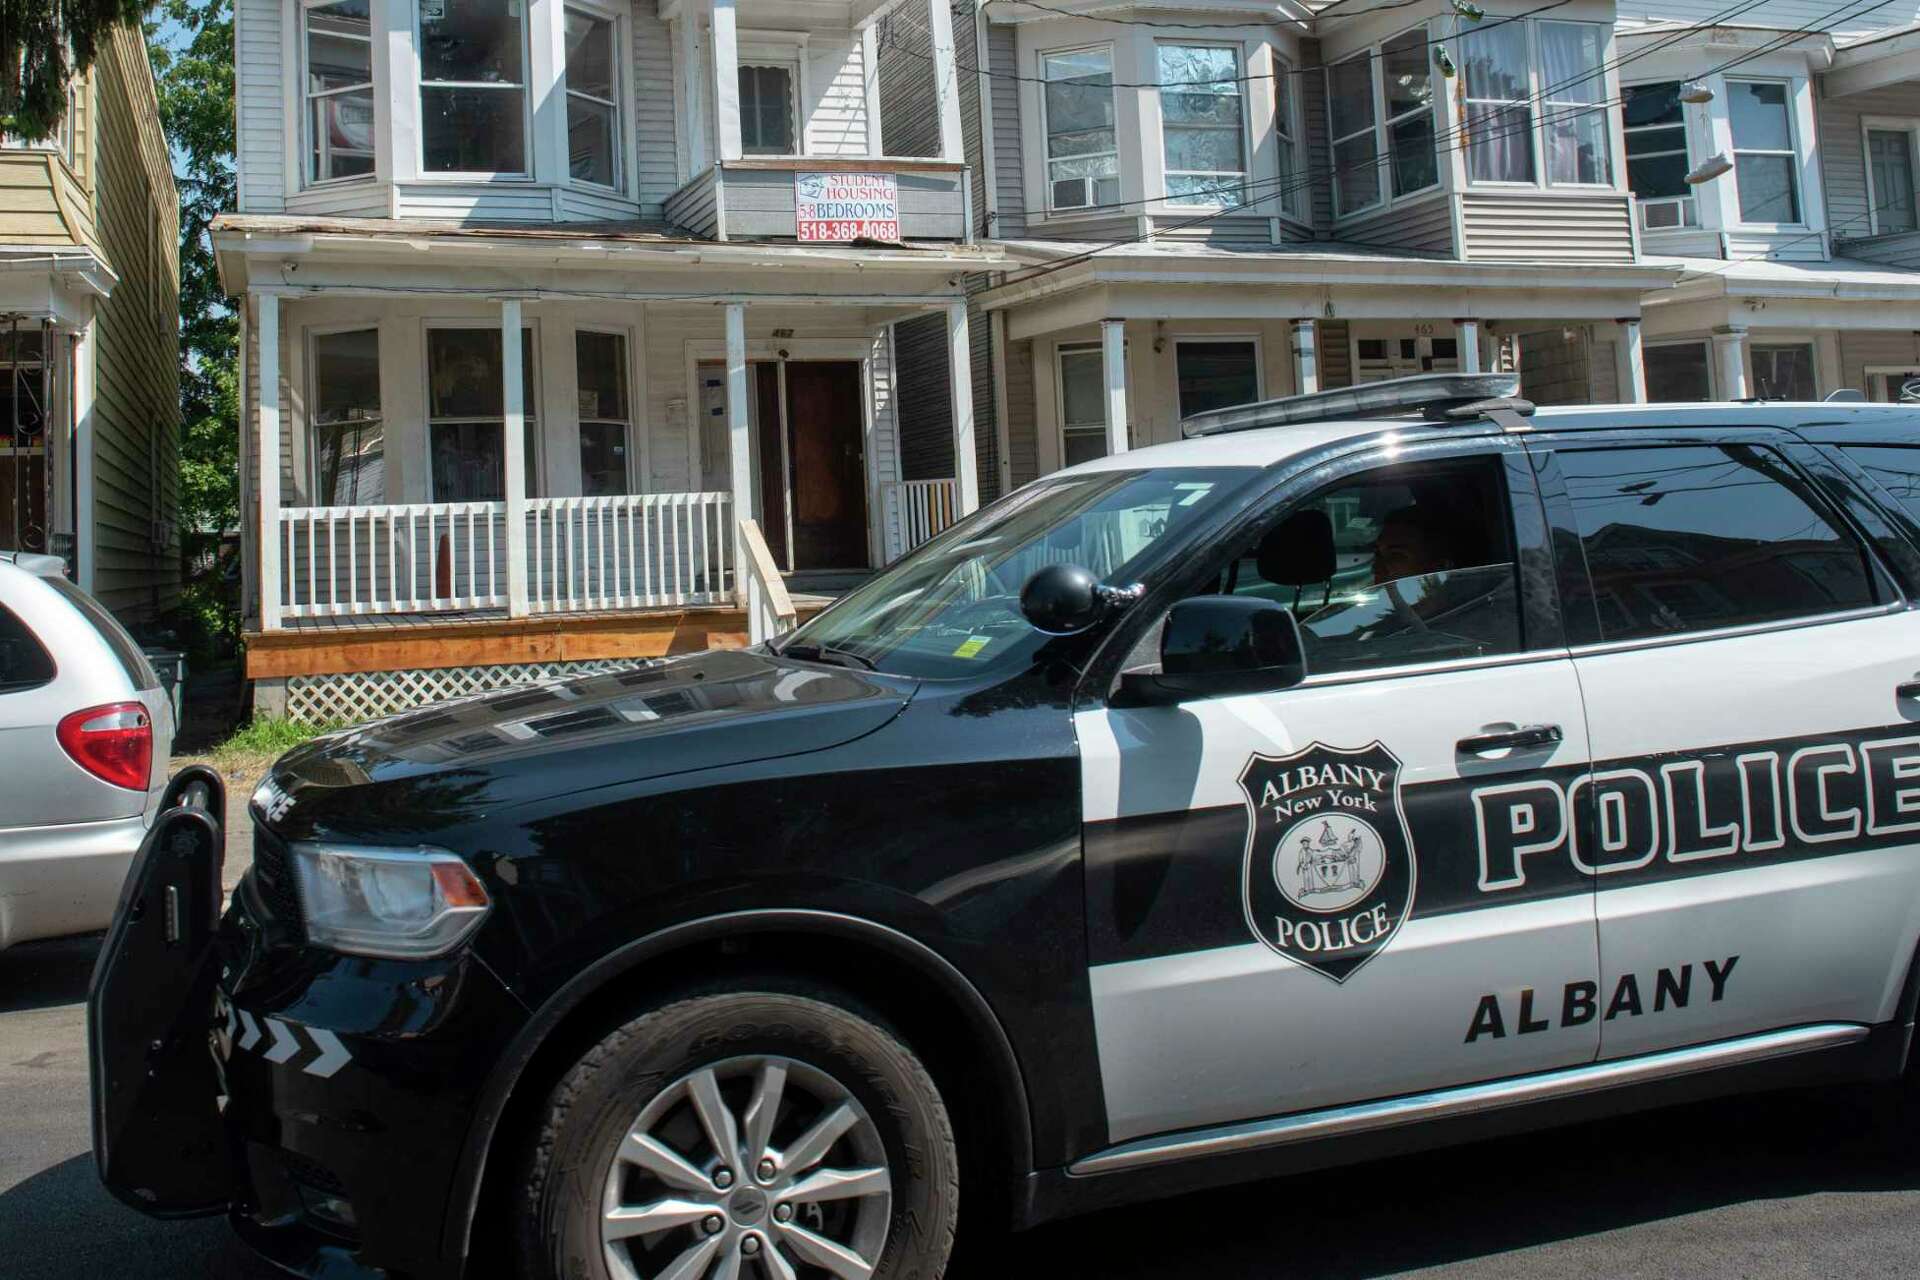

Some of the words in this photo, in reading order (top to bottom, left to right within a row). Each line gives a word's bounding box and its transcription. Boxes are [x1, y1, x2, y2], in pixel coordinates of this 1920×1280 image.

[827, 187, 893, 200] HOUSING
[830, 174, 886, 186] STUDENT
[817, 203, 894, 218] BEDROOMS
[1259, 763, 1386, 809] ALBANY
[1274, 798, 1323, 824] New
[1326, 789, 1377, 813] York
[1471, 736, 1920, 891] POLICE
[1275, 902, 1391, 952] POLICE
[1463, 955, 1741, 1044] ALBANY
